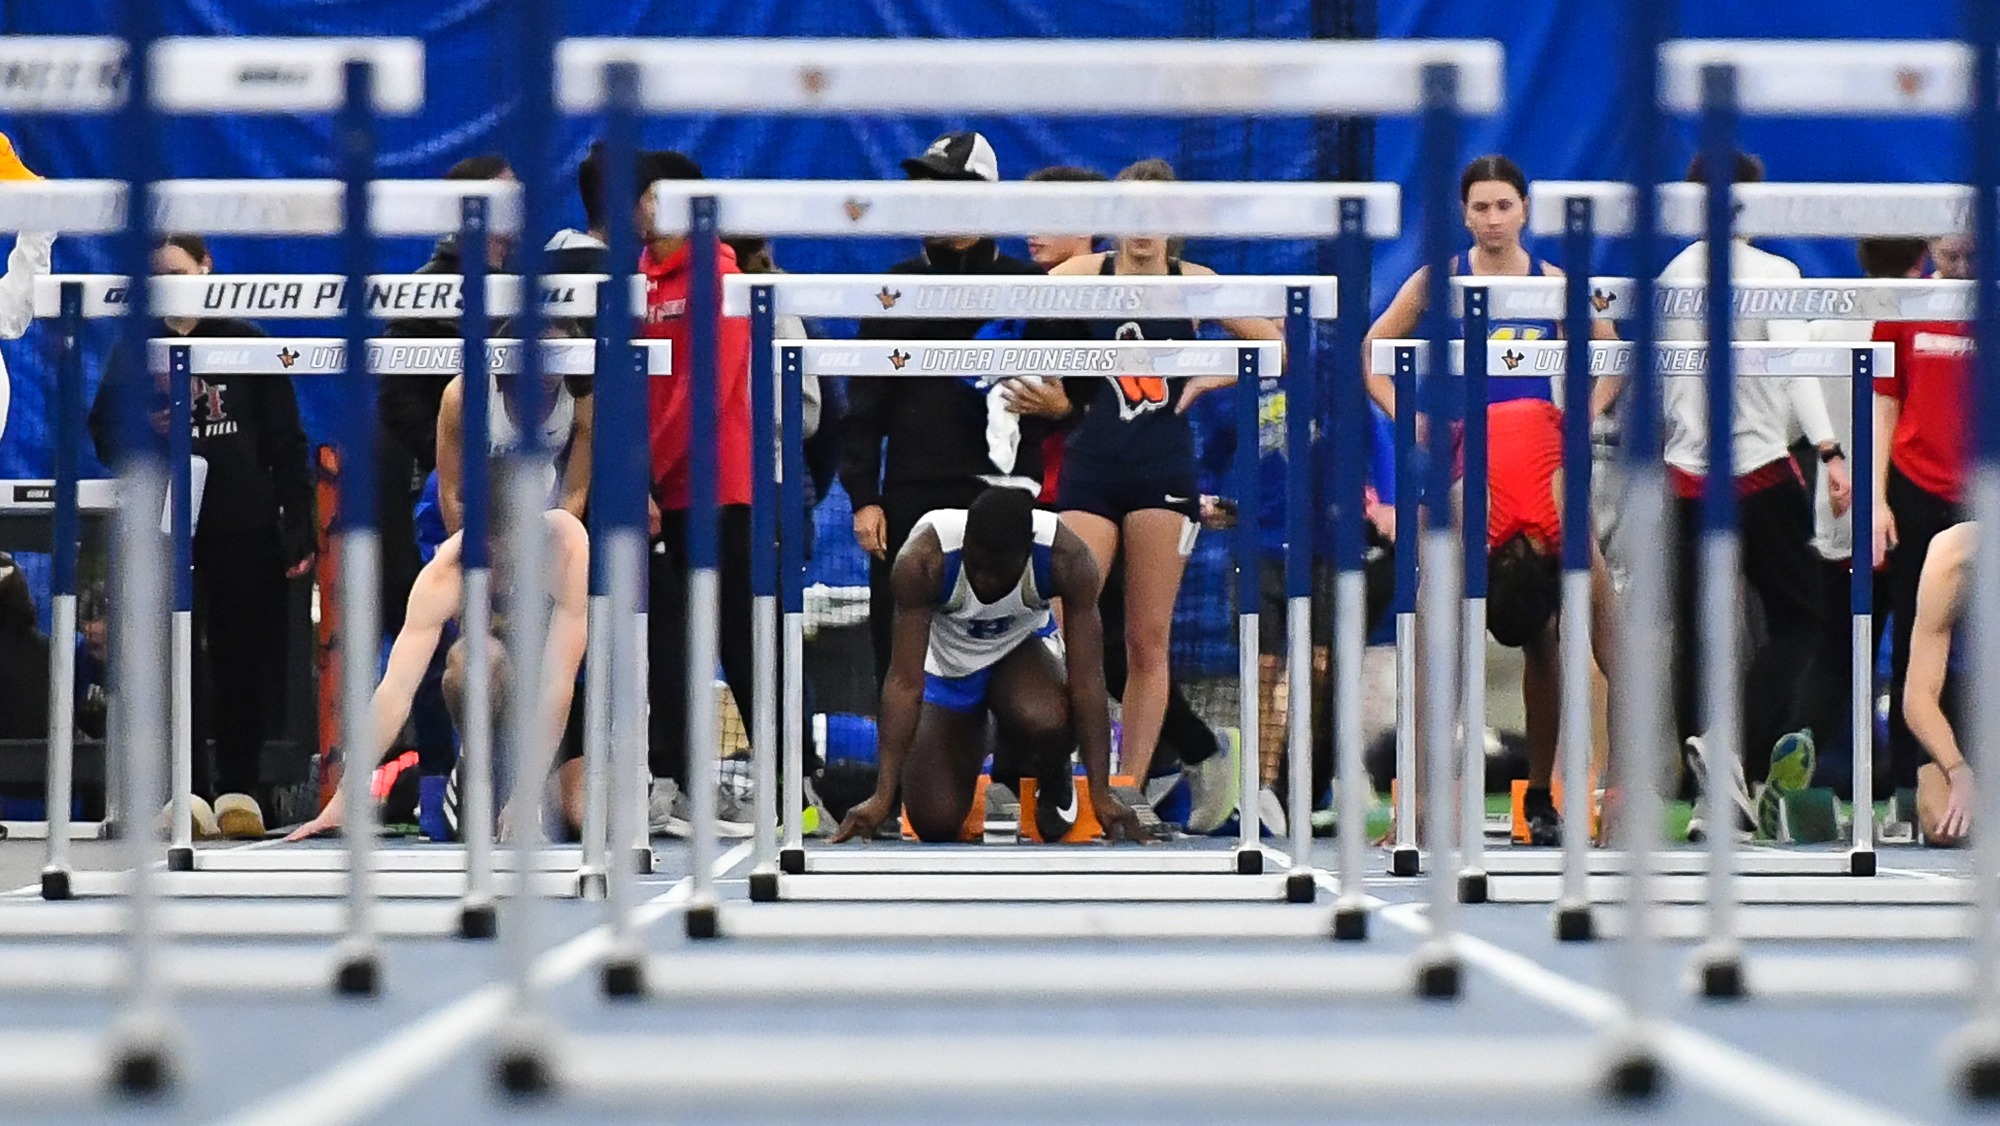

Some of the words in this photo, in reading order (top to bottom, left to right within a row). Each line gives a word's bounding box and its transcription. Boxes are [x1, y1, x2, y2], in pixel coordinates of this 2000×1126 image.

[204, 282, 303, 309] UTICA
[916, 284, 1001, 311] UTICA
[1012, 285, 1144, 311] PIONEERS
[1732, 288, 1857, 314] IONEERS
[390, 346, 507, 369] PIONES
[922, 348, 995, 371] UTICA
[999, 348, 1118, 371] PIONEERS
[1534, 348, 1608, 371] UTA
